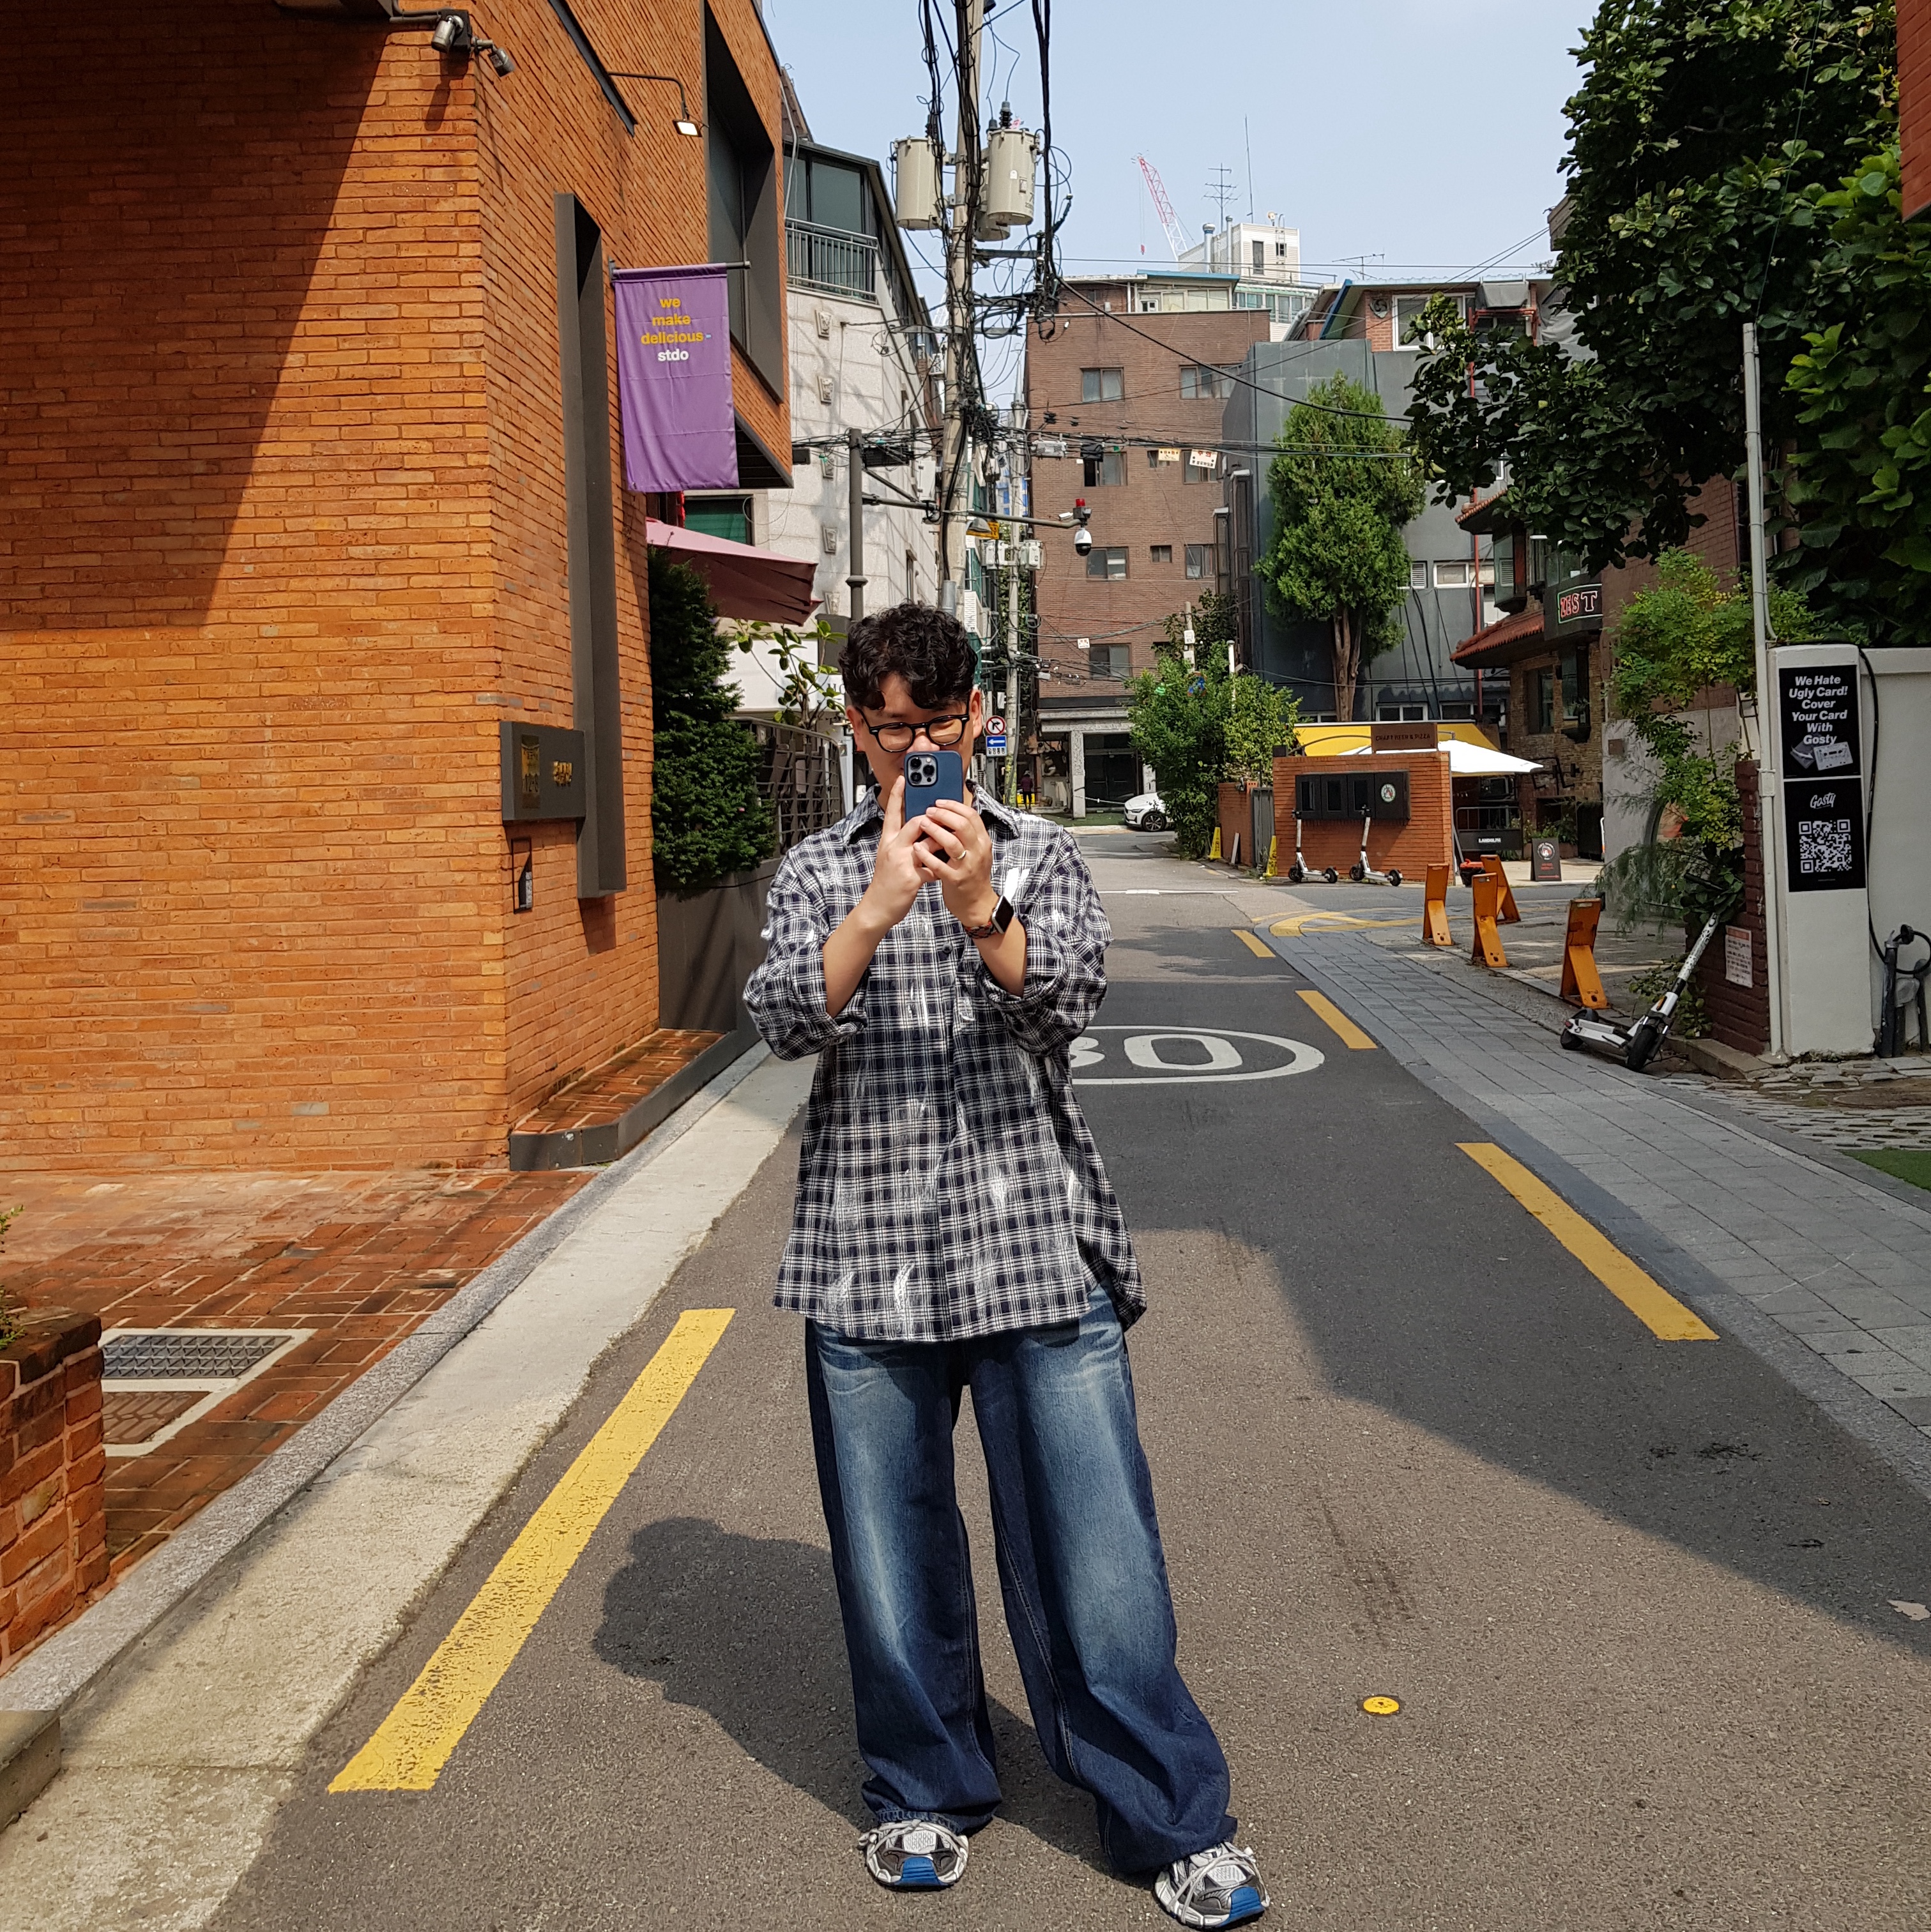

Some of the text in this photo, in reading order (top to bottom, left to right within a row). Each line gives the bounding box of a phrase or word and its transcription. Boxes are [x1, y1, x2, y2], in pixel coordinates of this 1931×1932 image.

[660, 298, 681, 308] we
[652, 314, 691, 326] make
[641, 331, 704, 344] delicious
[657, 348, 689, 361] stdo
[1560, 590, 1598, 619] ZEST
[1795, 675, 1842, 686] We Hate
[1789, 686, 1849, 700] Ugly Card!
[1801, 699, 1836, 710] Cover
[1792, 709, 1848, 722] Your Card
[1806, 722, 1833, 733] With
[1803, 734, 1838, 745] Gosty
[1810, 792, 1836, 809] Gosty
